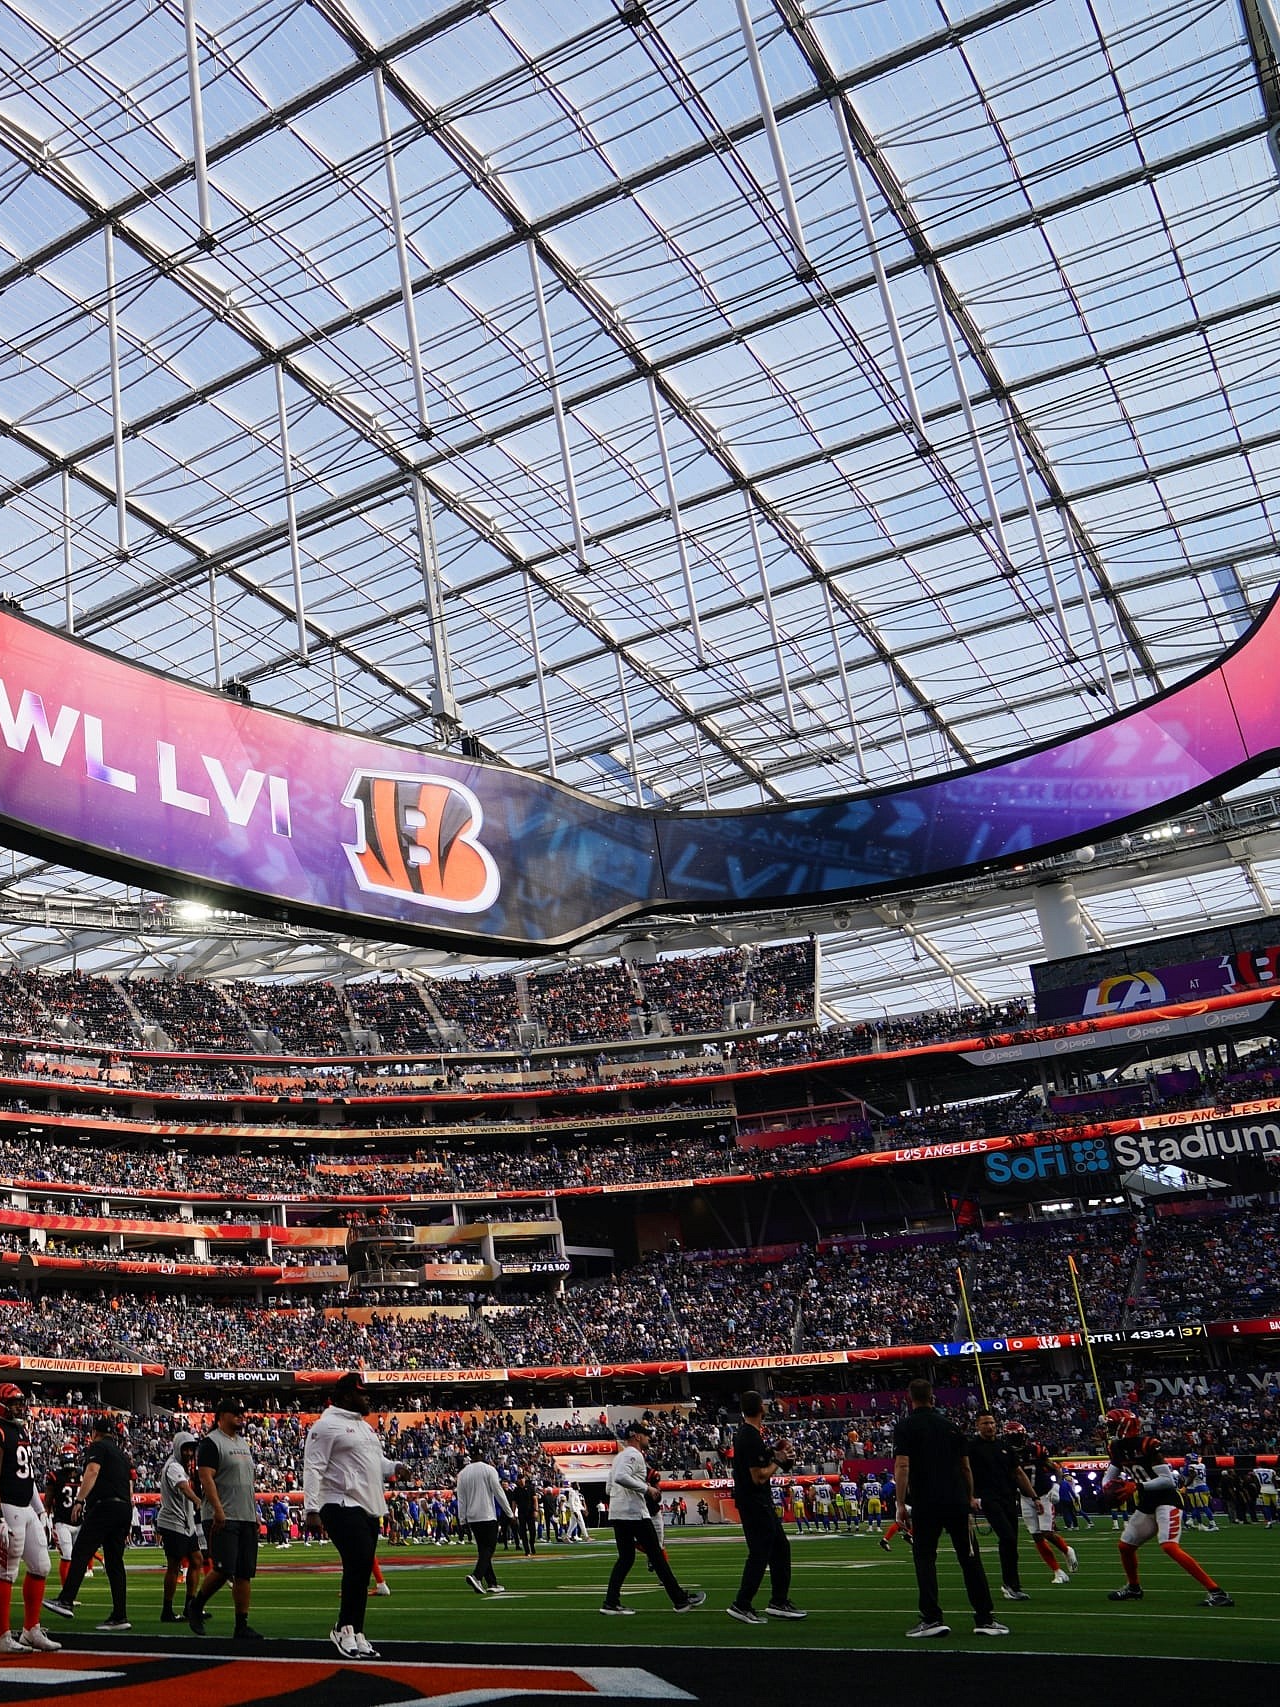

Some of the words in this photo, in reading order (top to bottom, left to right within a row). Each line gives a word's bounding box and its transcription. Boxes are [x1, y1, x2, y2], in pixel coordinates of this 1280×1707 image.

[156, 740, 292, 838] LVI
[1190, 979, 1199, 989] AT
[1220, 1009, 1250, 1023] pepsi
[1142, 1024, 1170, 1036] pepsi
[1069, 1036, 1096, 1049] pepsi
[996, 1048, 1023, 1060] pepsi
[1158, 1114, 1186, 1127] LOS
[1191, 1102, 1261, 1122] ANLES
[561, 1120, 603, 1129] LOCATION
[924, 1139, 988, 1157] ANGELES
[986, 1145, 1067, 1183] SoFi
[1114, 1123, 1280, 1167] Stadium
[1085, 1333, 1113, 1343] QTR
[1130, 1328, 1175, 1339] 43:34
[1182, 1327, 1202, 1336] 37
[30, 1358, 85, 1370] CINCINNATI
[88, 1362, 133, 1374] BENGALS
[699, 1357, 770, 1371] CINCINNATI
[775, 1353, 835, 1367] BENGALS
[204, 1372, 235, 1381] SUPER
[237, 1372, 266, 1381] BOWL
[266, 1373, 280, 1382] LVI
[378, 1373, 400, 1381] LOS
[402, 1372, 454, 1381] ANGELES
[458, 1370, 492, 1380] RAMS
[585, 1367, 602, 1377] LVI
[570, 1443, 587, 1453] LVI
[709, 1479, 735, 1488] SUPE
[1258, 1472, 1270, 1485] 12
